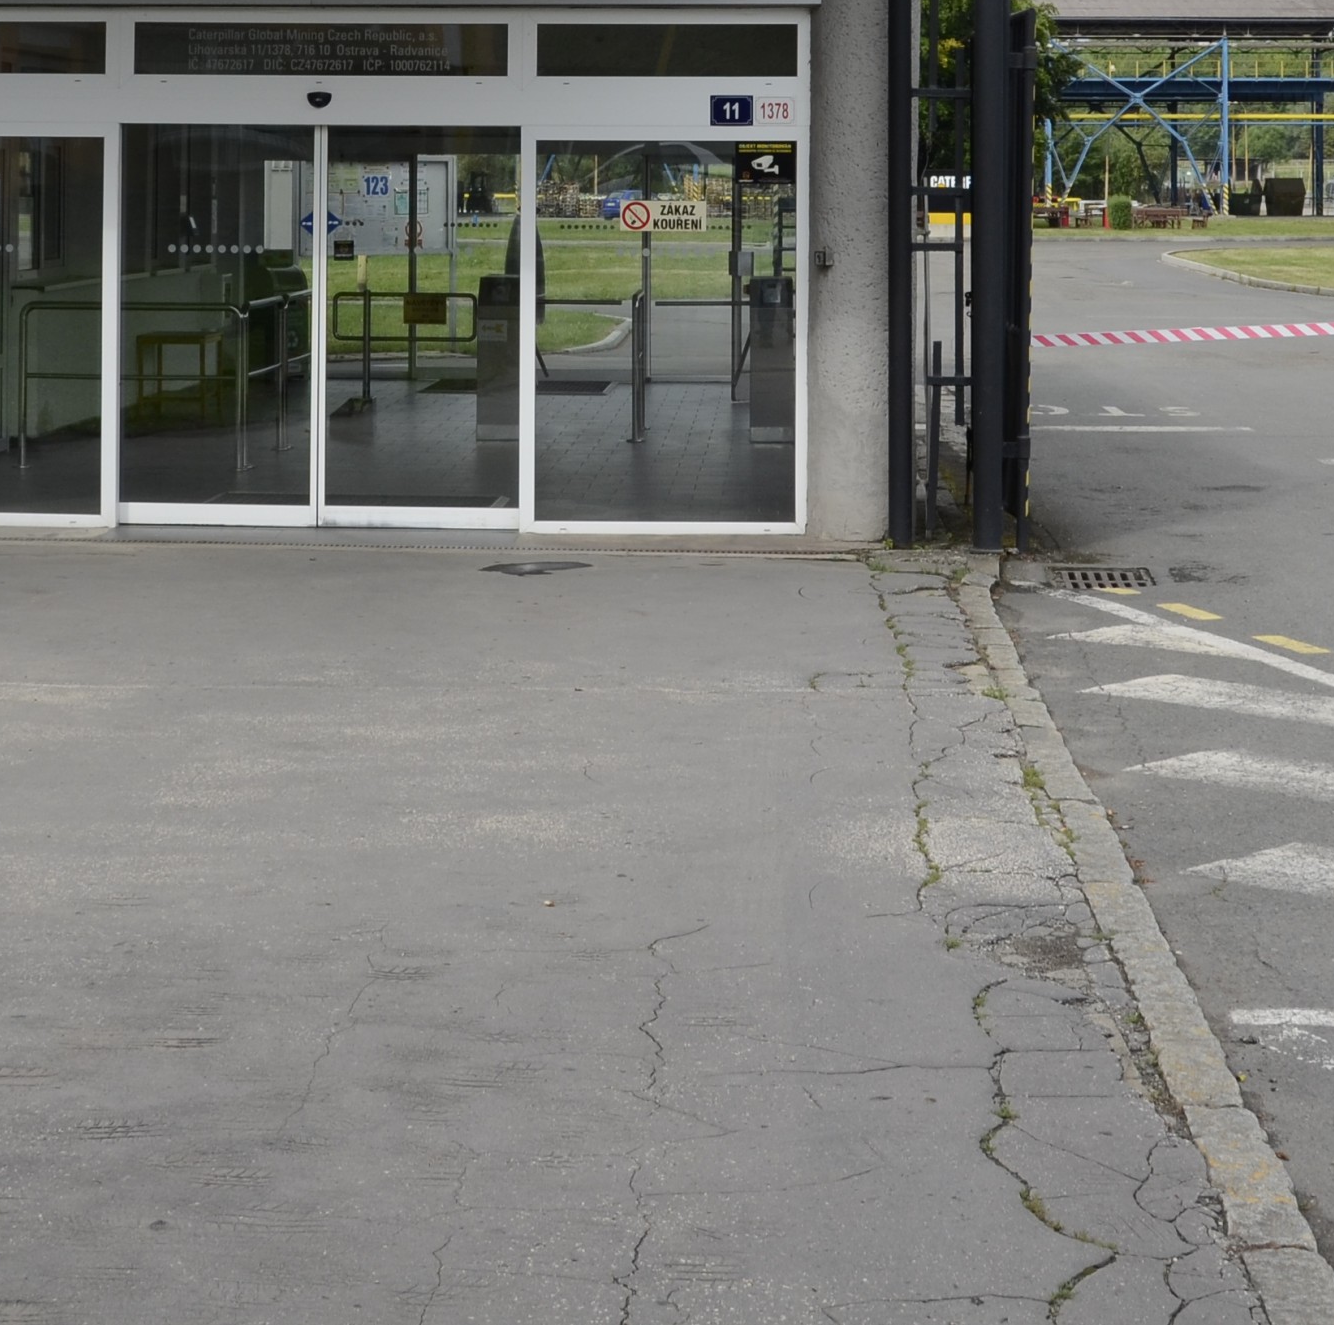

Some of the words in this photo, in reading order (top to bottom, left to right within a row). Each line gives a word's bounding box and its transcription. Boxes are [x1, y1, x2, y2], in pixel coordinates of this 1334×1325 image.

[188, 29, 245, 43] Caterpillar
[248, 28, 283, 41] Global
[286, 29, 324, 43] Mining
[328, 28, 361, 42] Czech
[364, 29, 416, 44] Republic,
[418, 32, 438, 42] a.s.
[251, 45, 294, 58] 11/1378,
[297, 45, 315, 56] 716
[319, 45, 330, 56] 10
[336, 45, 379, 56] Ostrava
[390, 44, 449, 57] Radvanice
[290, 59, 354, 71] CZ47672617
[390, 59, 451, 71] 1000762114
[722, 101, 740, 120] 11
[760, 102, 789, 120] 1378
[363, 176, 389, 196] 123
[659, 202, 696, 216] ZÁKAZ
[653, 216, 702, 230] KOUŘENÍ
